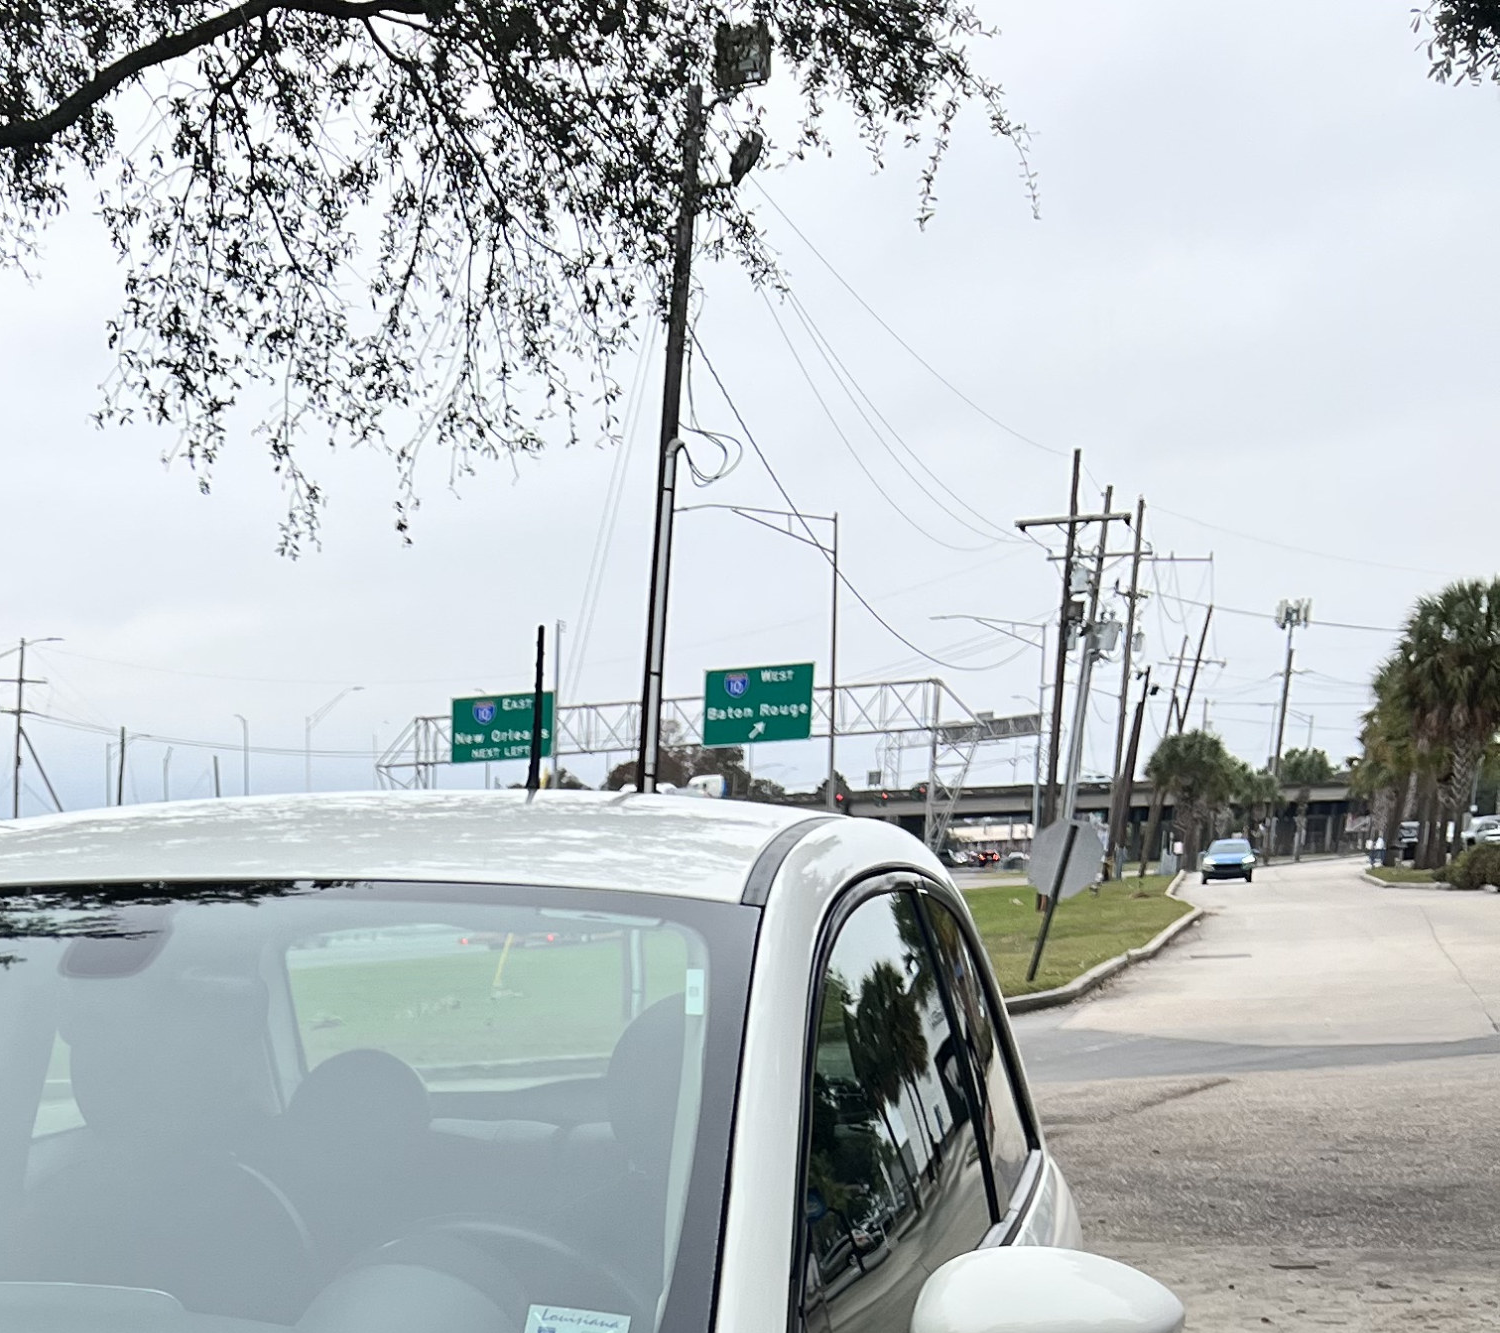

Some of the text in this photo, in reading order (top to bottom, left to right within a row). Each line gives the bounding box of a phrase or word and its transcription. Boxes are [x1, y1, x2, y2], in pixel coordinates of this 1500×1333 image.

[730, 681, 744, 694] 10
[478, 698, 533, 721] 10 EAST
[707, 703, 809, 720] Baton Rouge
[455, 729, 550, 745] New Orleas
[471, 745, 531, 759] NEXT LEFT
[542, 1308, 619, 1328] Louisiana
